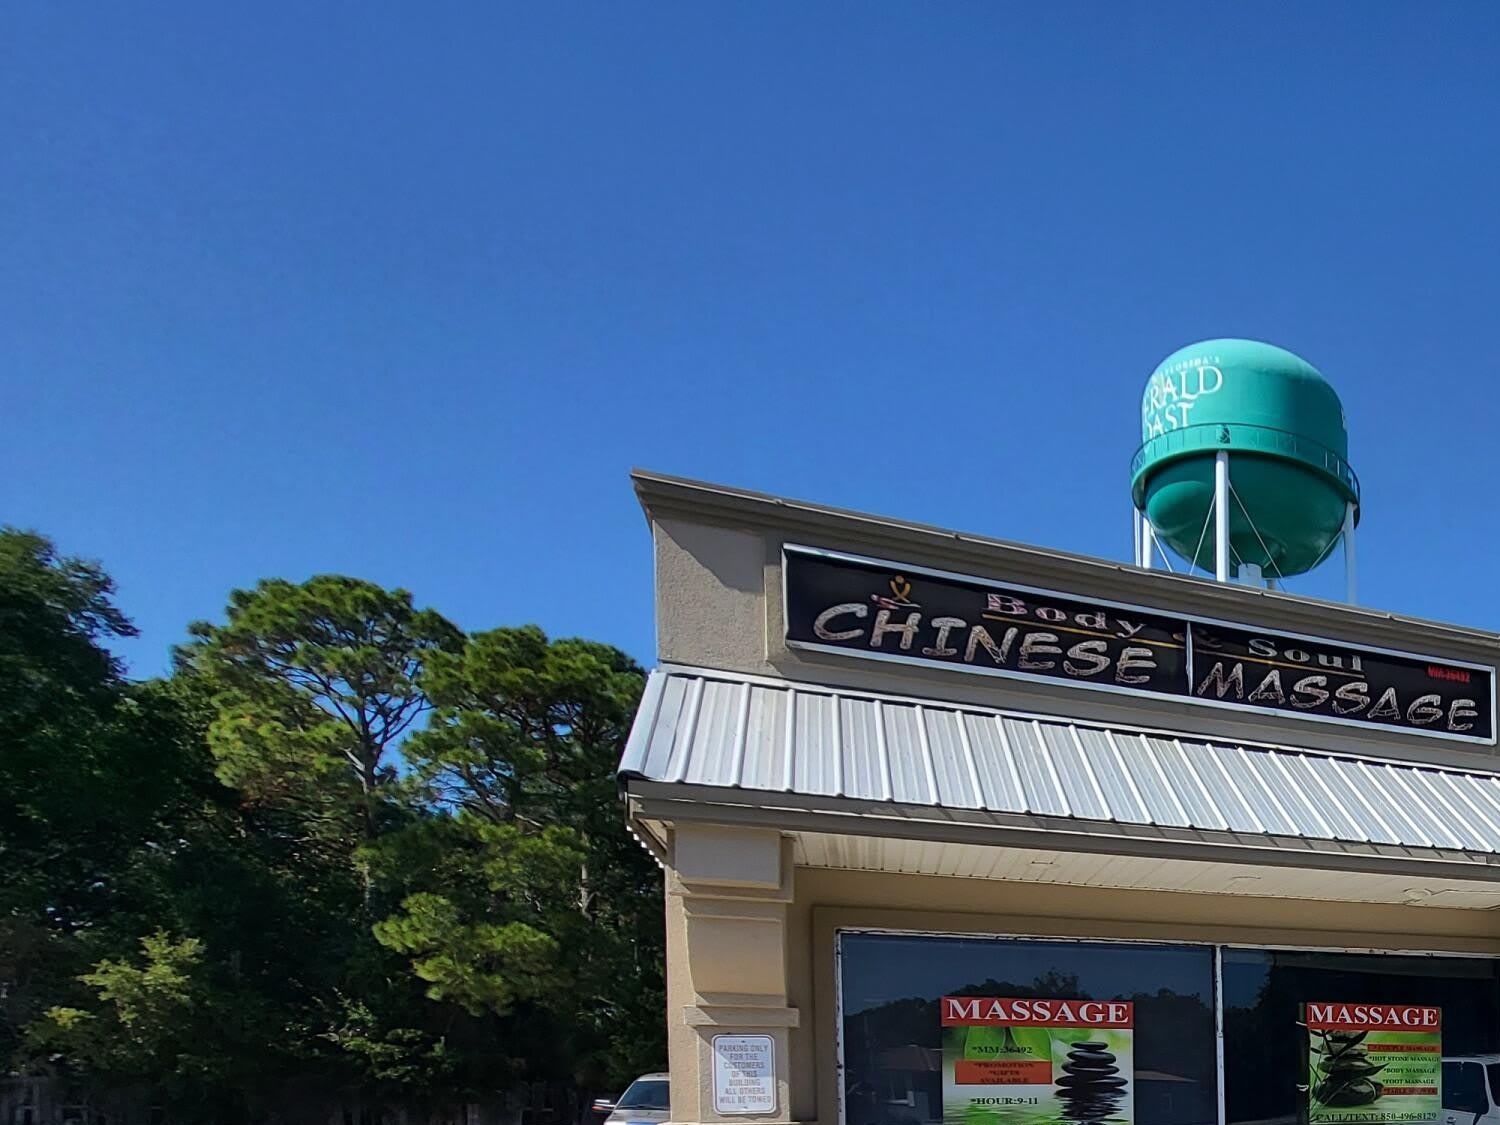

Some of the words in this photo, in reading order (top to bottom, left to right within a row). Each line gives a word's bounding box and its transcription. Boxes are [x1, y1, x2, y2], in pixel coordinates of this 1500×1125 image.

[987, 593, 1147, 639] Body
[1248, 638, 1364, 672] Soul
[813, 602, 1157, 684] CHINESE
[1196, 661, 1479, 731] MASSAGE
[947, 999, 1129, 1024] MASSAGE
[1309, 1004, 1438, 1026] MASSAGE
[718, 1044, 749, 1053] PARKING
[750, 1044, 768, 1053] ONLY
[729, 1052, 744, 1061] FOR
[745, 1052, 759, 1061] THE
[724, 1061, 765, 1069] CUSTOMERS
[731, 1070, 741, 1078] OF
[729, 1079, 761, 1087] BUILDING
[725, 1087, 737, 1095] ALL
[739, 1087, 766, 1095] OTHERS
[719, 1096, 736, 1104] WILL
[738, 1096, 746, 1104] BE
[747, 1095, 772, 1103] TOWED
[1380, 1112, 1437, 1121] 850-496-8129
